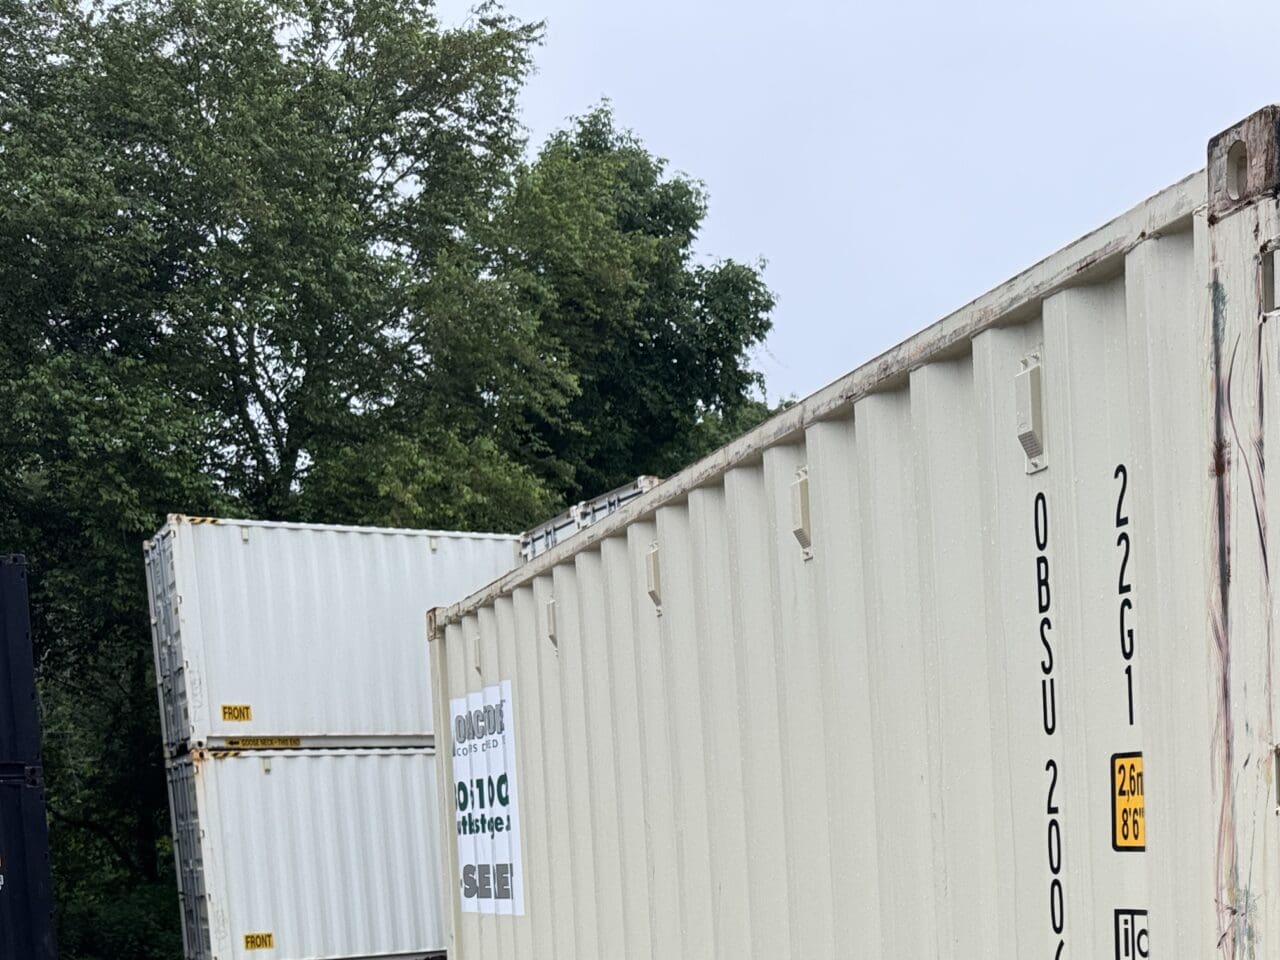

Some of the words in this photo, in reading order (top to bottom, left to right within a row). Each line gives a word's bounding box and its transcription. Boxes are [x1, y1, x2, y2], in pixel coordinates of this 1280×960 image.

[1034, 491, 1056, 736] OBSU
[1114, 463, 1134, 726] 22G1
[223, 706, 250, 720] FRONT
[245, 934, 272, 950] FRONT
